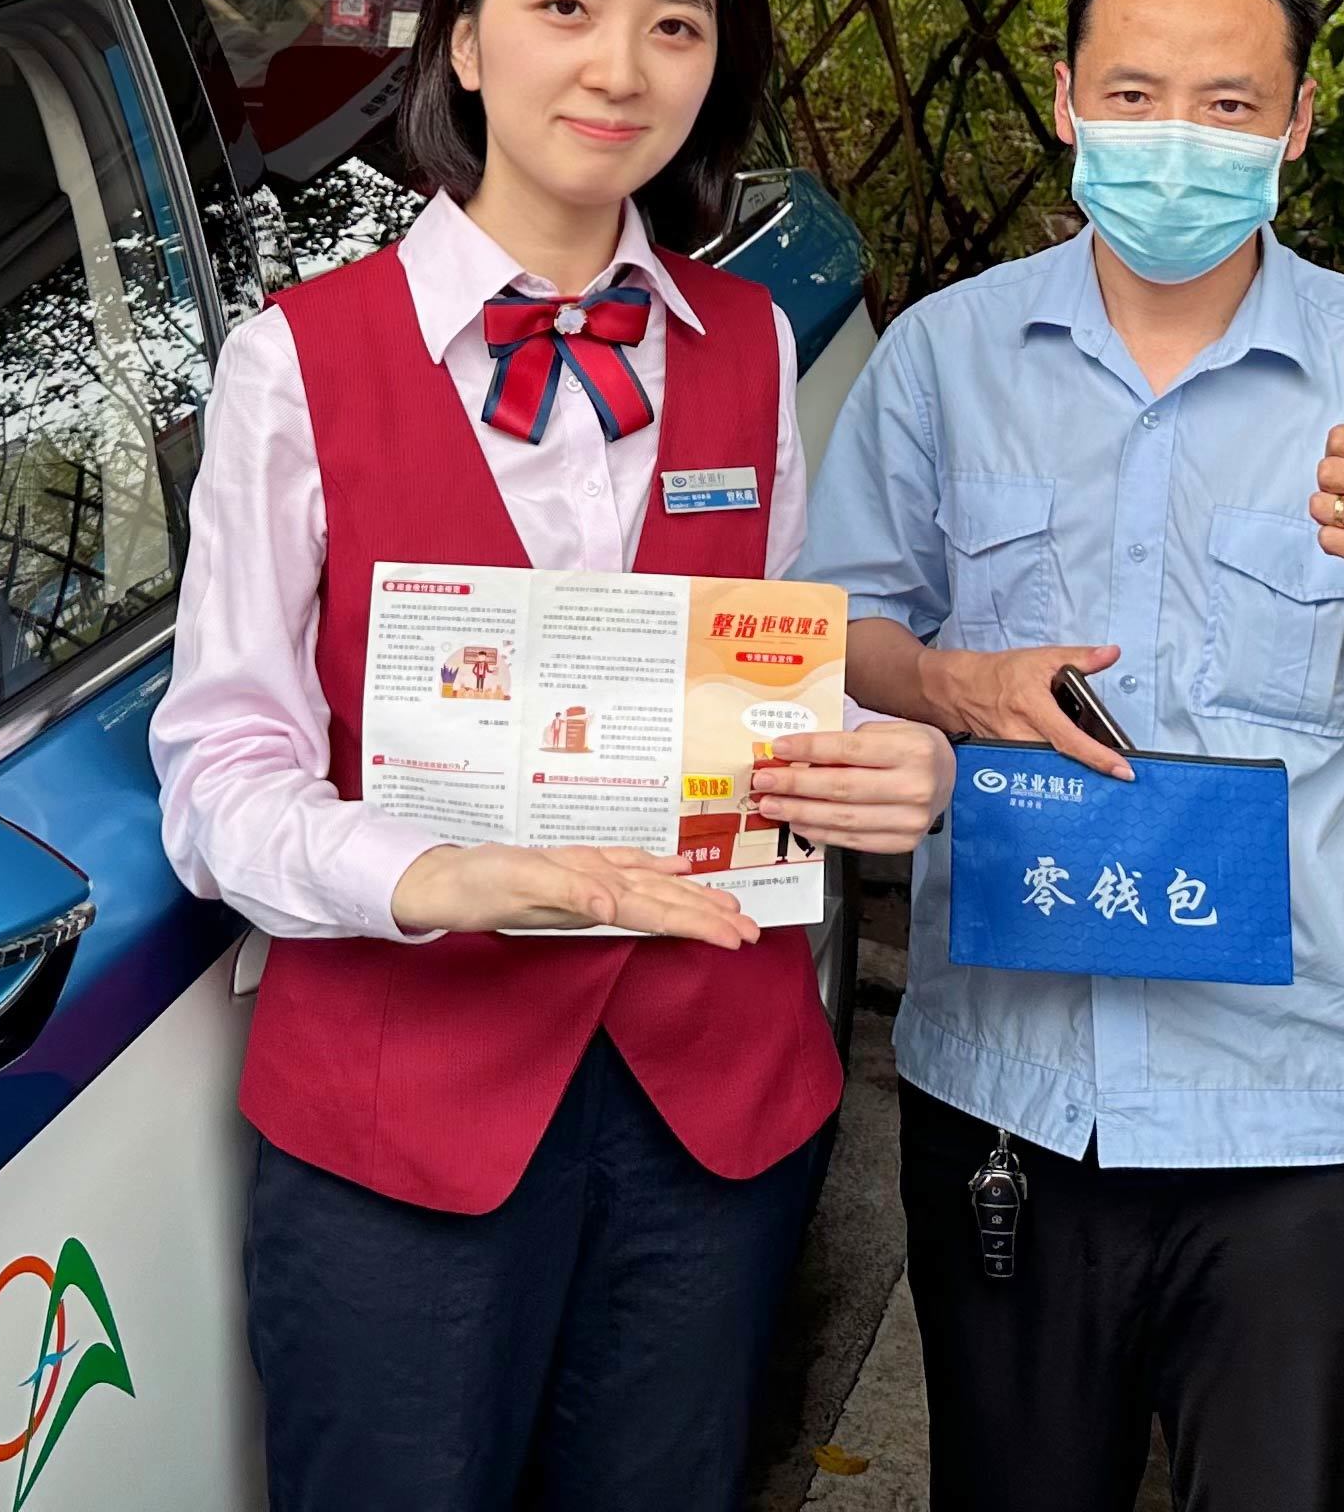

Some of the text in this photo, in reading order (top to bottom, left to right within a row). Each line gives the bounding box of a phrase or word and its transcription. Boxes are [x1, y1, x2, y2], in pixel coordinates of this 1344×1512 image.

[710, 613, 829, 639] 整治拒收现金
[687, 778, 729, 796] 拒收现金
[1010, 772, 1085, 795] 兴业银行
[1021, 856, 1219, 926] 零钱包
